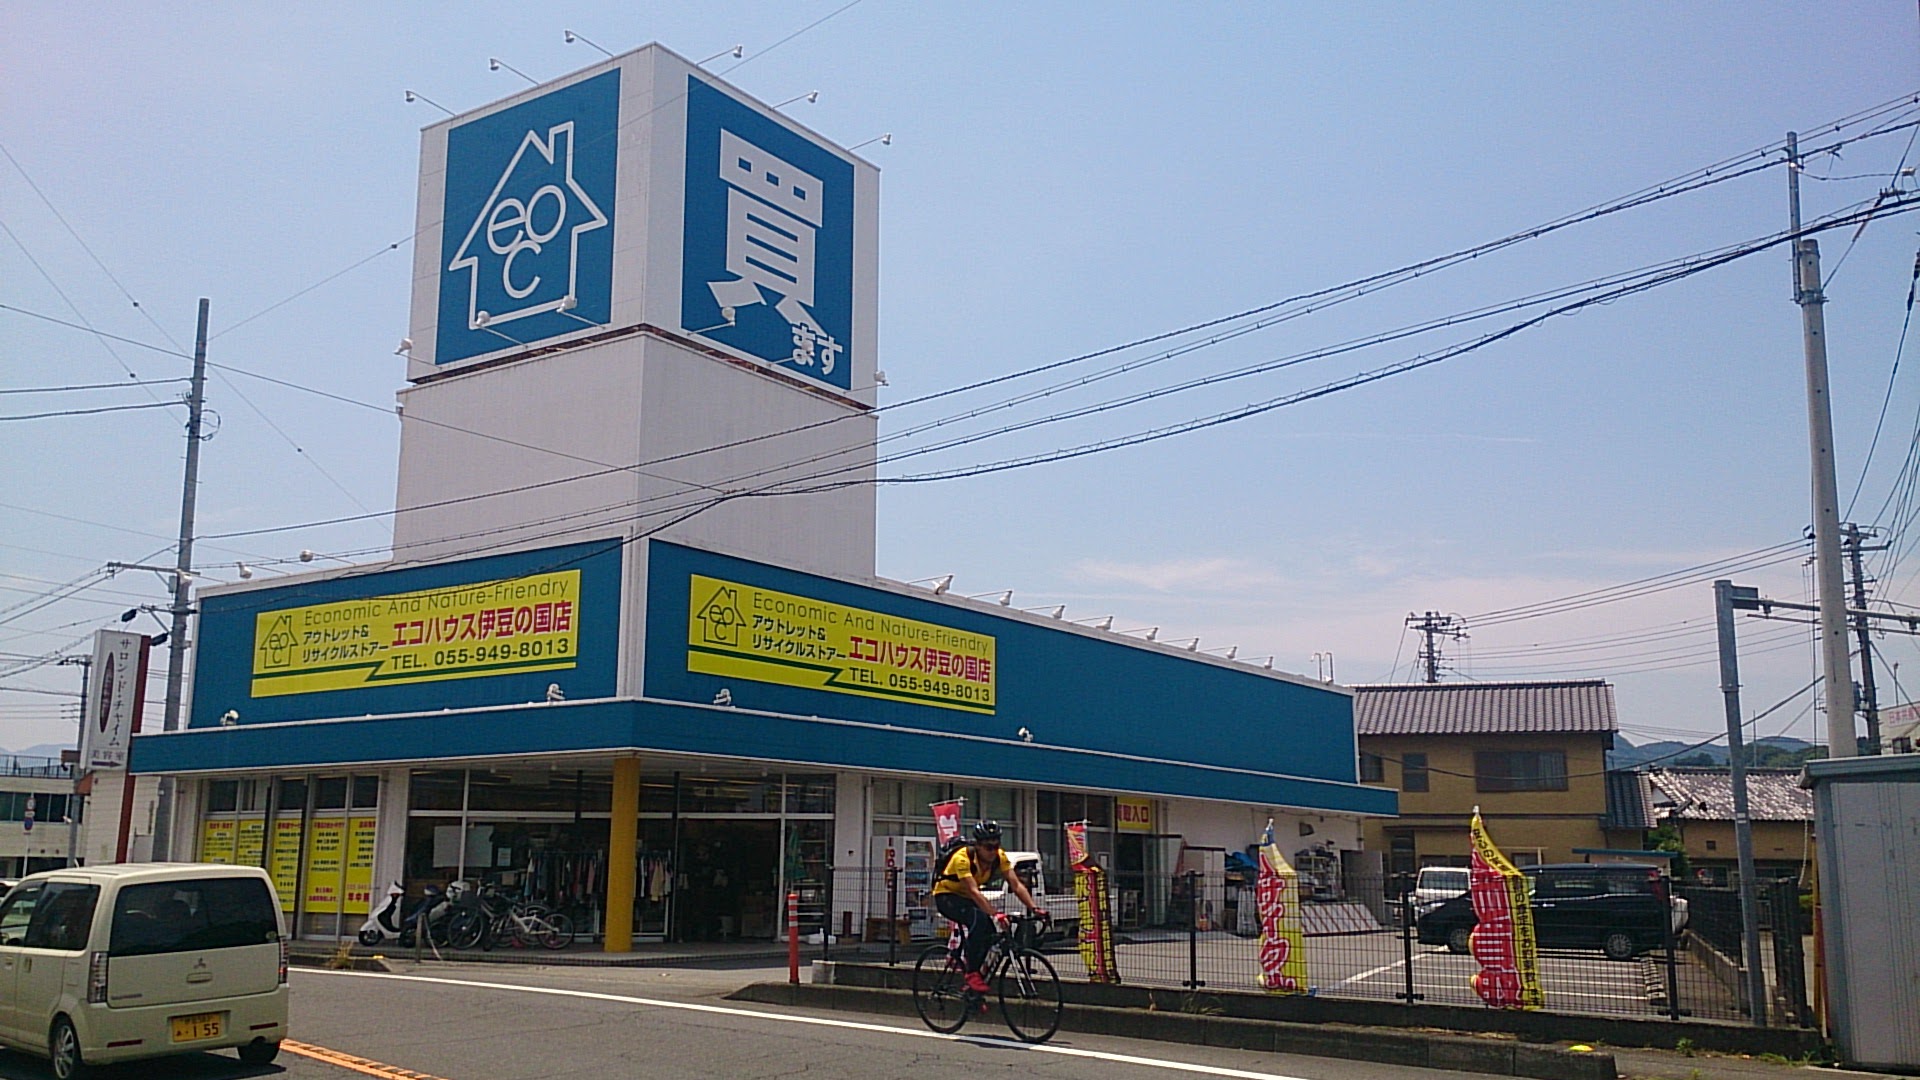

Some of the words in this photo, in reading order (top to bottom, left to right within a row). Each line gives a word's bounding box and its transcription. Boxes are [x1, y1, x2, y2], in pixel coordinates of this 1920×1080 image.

[304, 601, 382, 627] Economic
[388, 596, 421, 615] And
[392, 600, 572, 647] エコハウス伊豆の国店
[753, 592, 837, 625] Economic
[844, 611, 874, 632] And
[434, 638, 569, 666] 055-949-8013
[850, 636, 991, 684] エコハウス伊豆の国店
[889, 673, 990, 701] 055-949-8013
